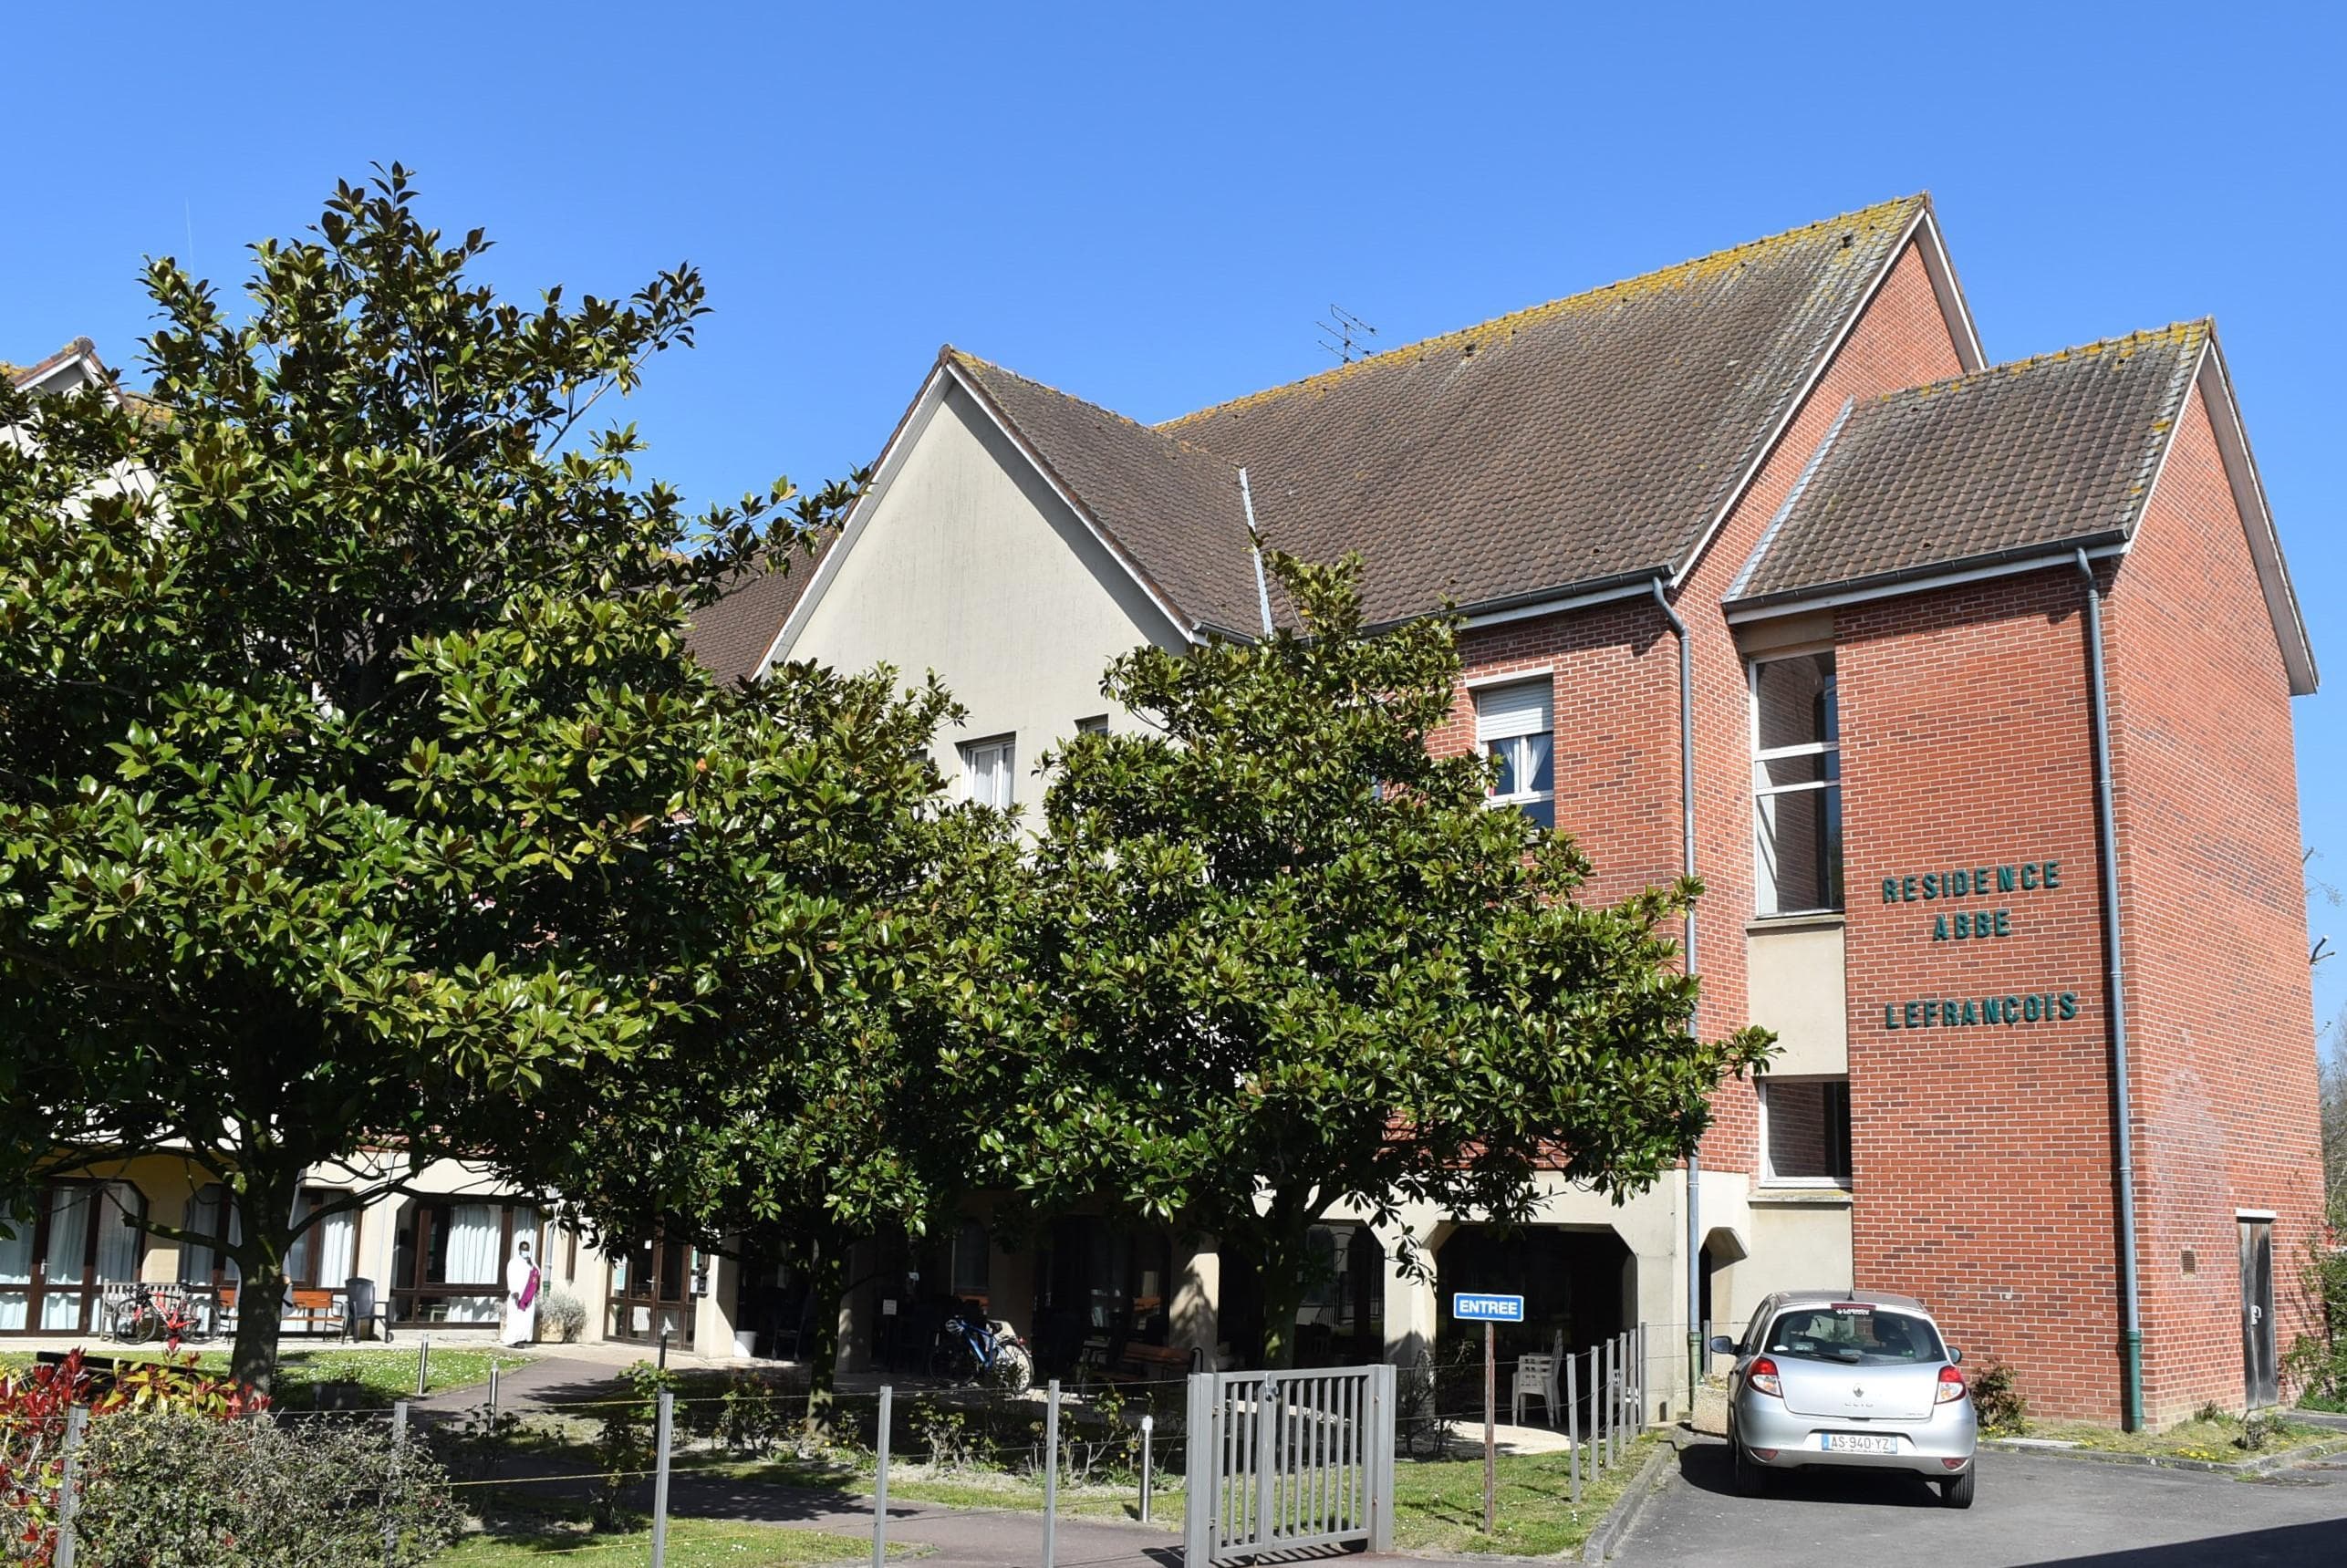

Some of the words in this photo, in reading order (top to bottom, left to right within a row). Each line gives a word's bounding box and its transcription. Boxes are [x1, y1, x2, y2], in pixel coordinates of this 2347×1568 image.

[1882, 860, 2060, 904] RESIDENCE
[1932, 909, 2011, 941] ABBE
[1459, 1300, 1518, 1315] ENTREE
